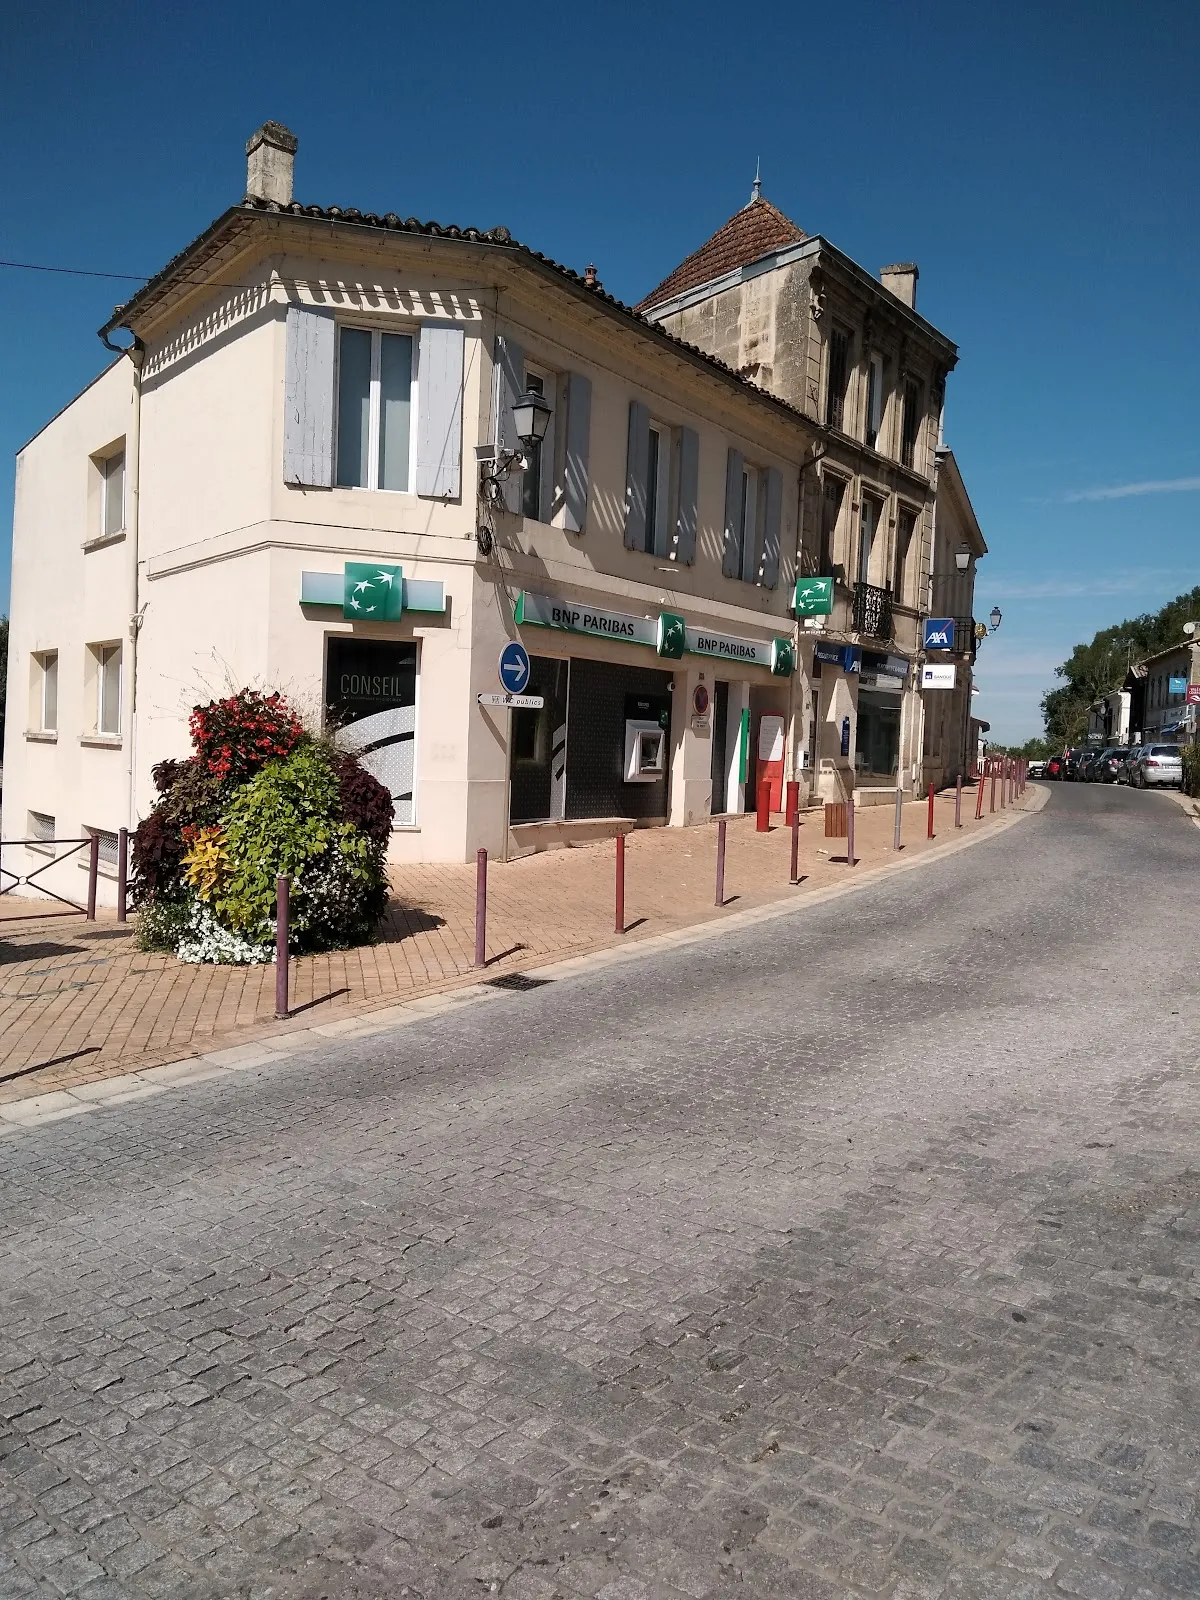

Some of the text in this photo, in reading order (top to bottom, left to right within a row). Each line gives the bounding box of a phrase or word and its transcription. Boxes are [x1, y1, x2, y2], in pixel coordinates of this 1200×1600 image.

[552, 608, 634, 636] BNP PARIBAS
[926, 632, 948, 643] AXA
[698, 638, 756, 658] BNP PARIBAS
[341, 674, 402, 696] CONSEIL
[516, 698, 541, 706] publics
